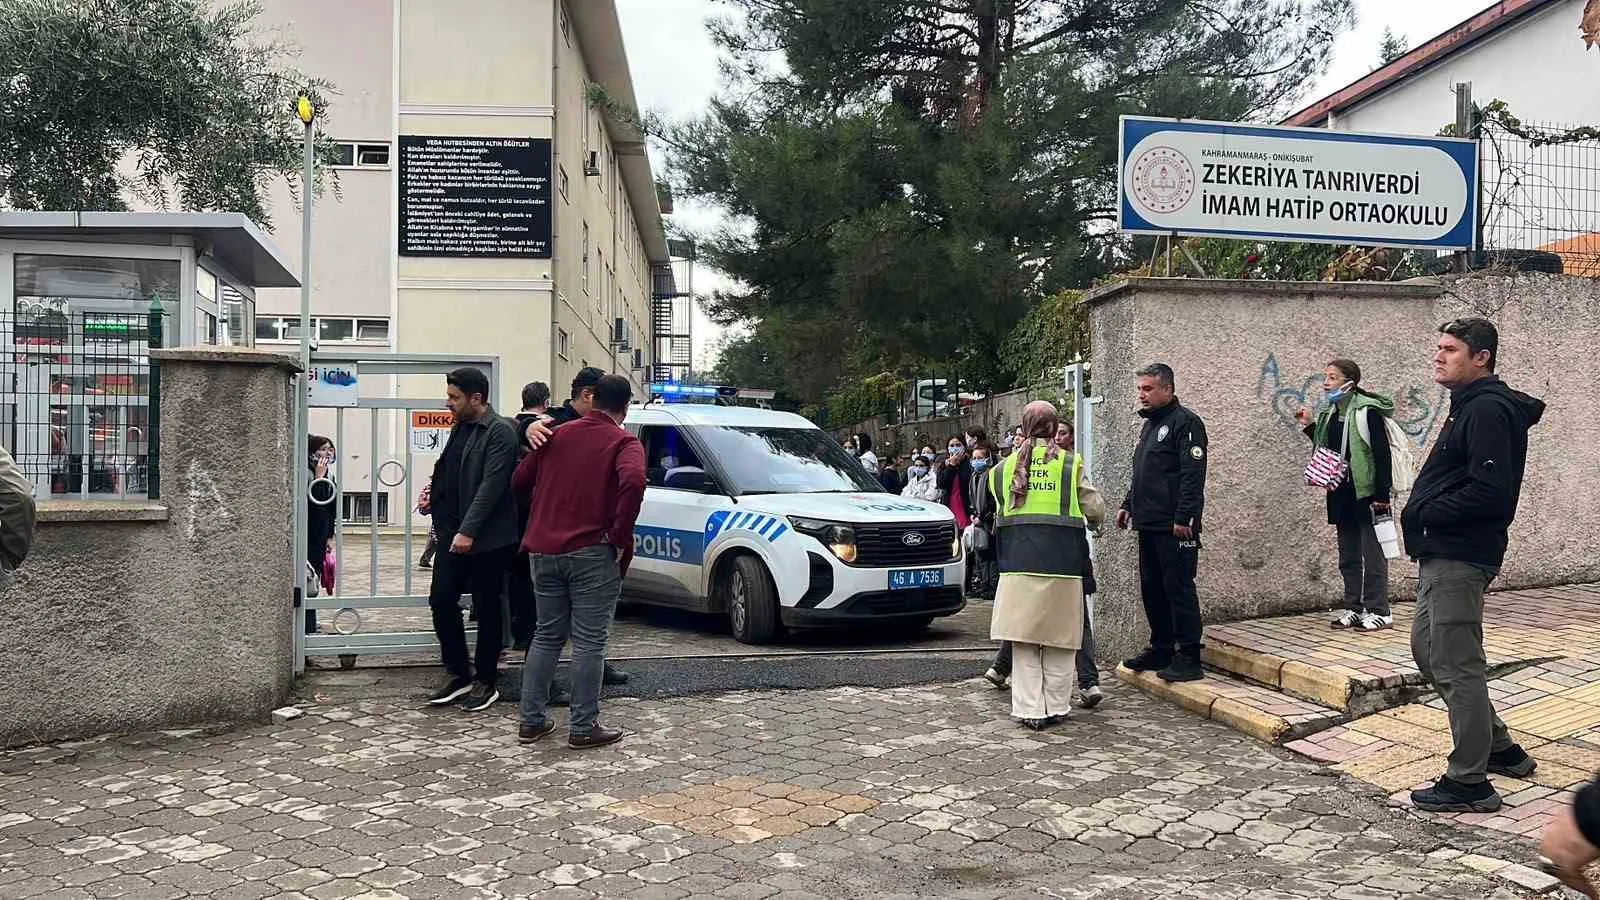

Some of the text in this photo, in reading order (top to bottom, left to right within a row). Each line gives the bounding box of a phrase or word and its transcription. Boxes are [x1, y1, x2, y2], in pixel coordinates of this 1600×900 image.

[1202, 150, 1267, 160] KAHRAMANMARAŞ
[1202, 163, 1298, 188] ZEKERİYA
[1302, 170, 1420, 195] TANRIVERDİ
[1202, 190, 1448, 226] İMAM HATİP ORTAOKULU
[418, 413, 456, 425] DİKKA
[1027, 480, 1056, 491] EVLİSİ
[633, 531, 681, 558] POLİS
[894, 572, 939, 584] 46 A 7536
